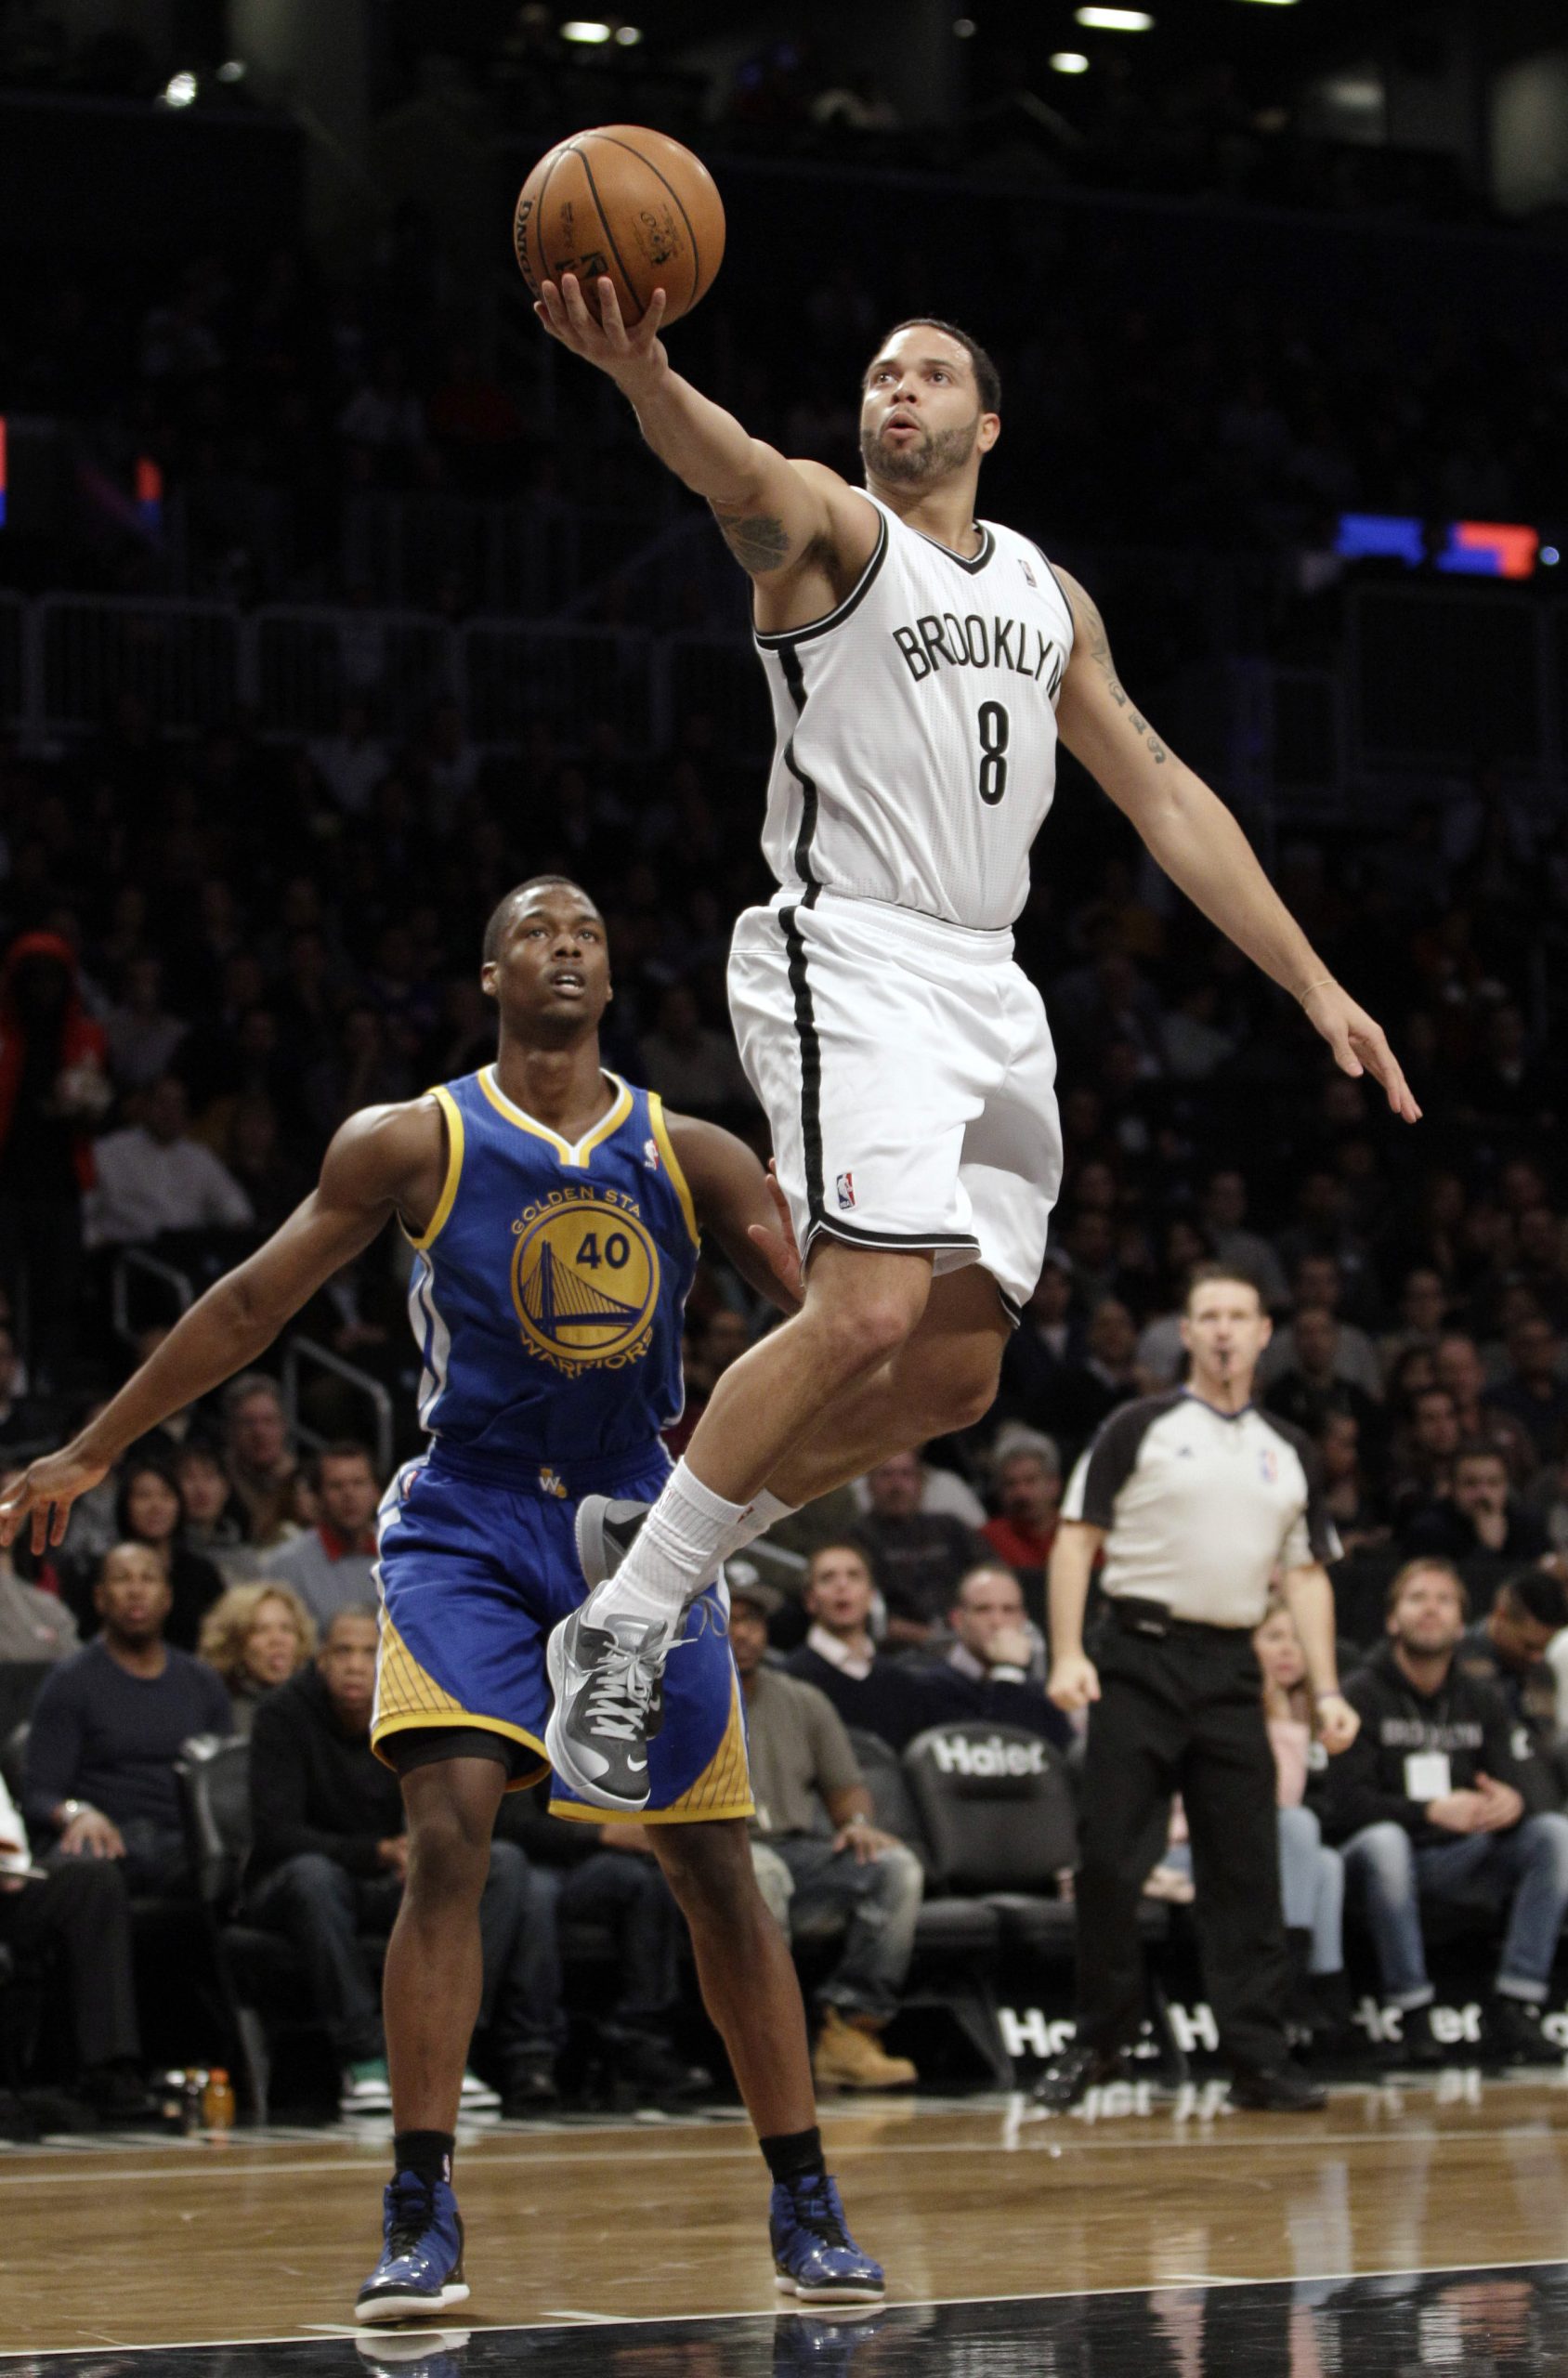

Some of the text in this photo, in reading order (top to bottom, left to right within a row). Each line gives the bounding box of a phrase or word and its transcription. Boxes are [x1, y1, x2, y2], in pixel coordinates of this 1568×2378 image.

[892, 613, 1062, 700] BROOKLYN
[978, 700, 1010, 806] 8
[511, 1186, 641, 1235] GOLDEN STA
[576, 1233, 630, 1270] 40
[933, 1734, 1048, 1776] Haier
